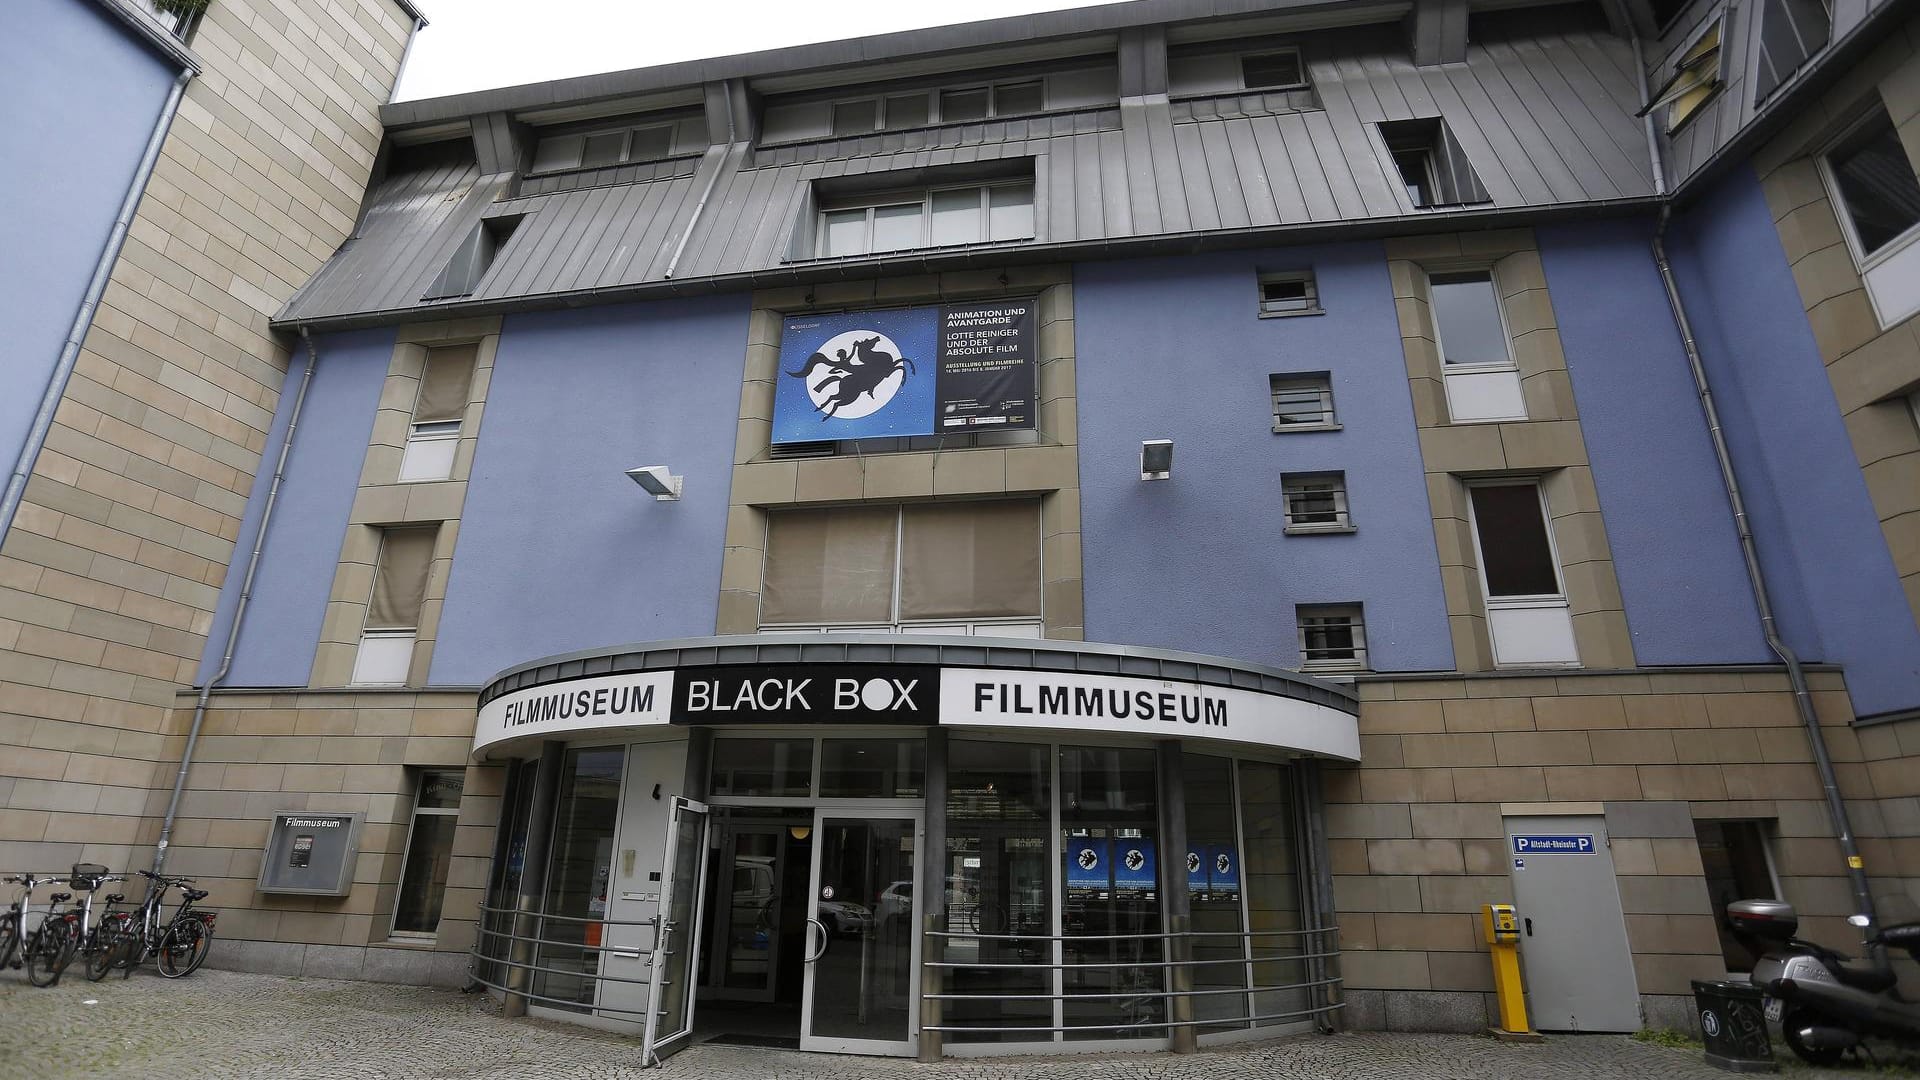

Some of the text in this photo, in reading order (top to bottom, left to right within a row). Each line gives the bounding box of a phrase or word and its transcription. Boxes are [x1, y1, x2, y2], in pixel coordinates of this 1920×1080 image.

[947, 308, 1025, 320] ANIMATION UND
[947, 317, 1011, 328] AVANTGARDE
[947, 329, 1018, 340] LOTTE REINIGER
[946, 340, 967, 348] UND
[946, 345, 1018, 356] ABSOLUTE FILM
[687, 677, 919, 712] BLACK BOX
[503, 684, 655, 729] FILMMUSEUM
[974, 682, 1228, 727] FILMMUSEUM
[285, 817, 340, 828] Filmmuseum
[1517, 838, 1589, 850] P Altstadt-Rheinufer P
